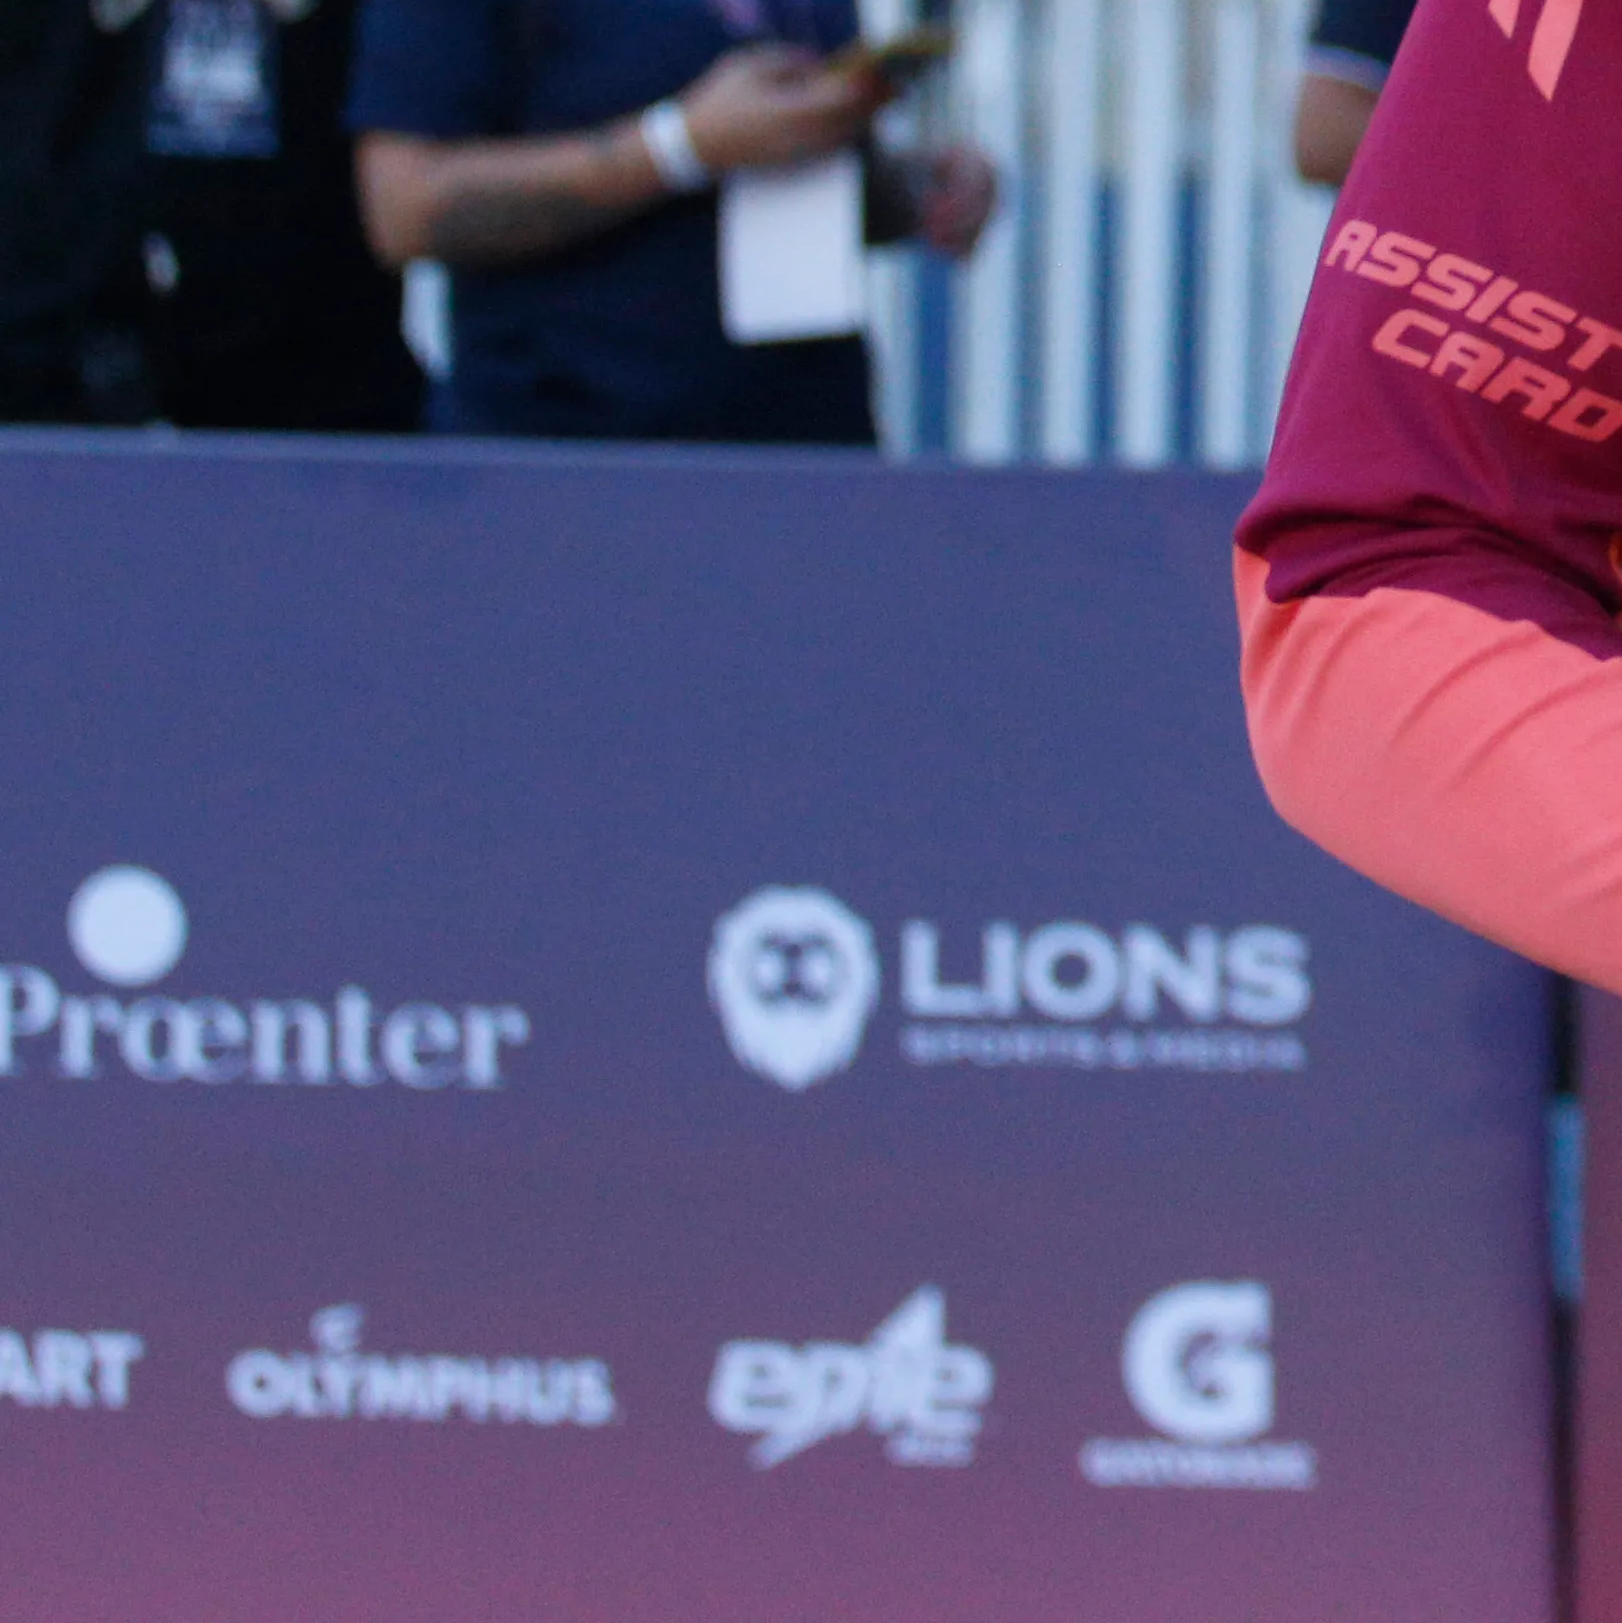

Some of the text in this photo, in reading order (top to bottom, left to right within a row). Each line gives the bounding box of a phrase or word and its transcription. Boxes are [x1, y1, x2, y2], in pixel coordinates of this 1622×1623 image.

[902, 918, 1311, 1026] LIONS
[226, 1347, 617, 1426] OLYMPHUS
[1121, 1279, 1275, 1444] G
